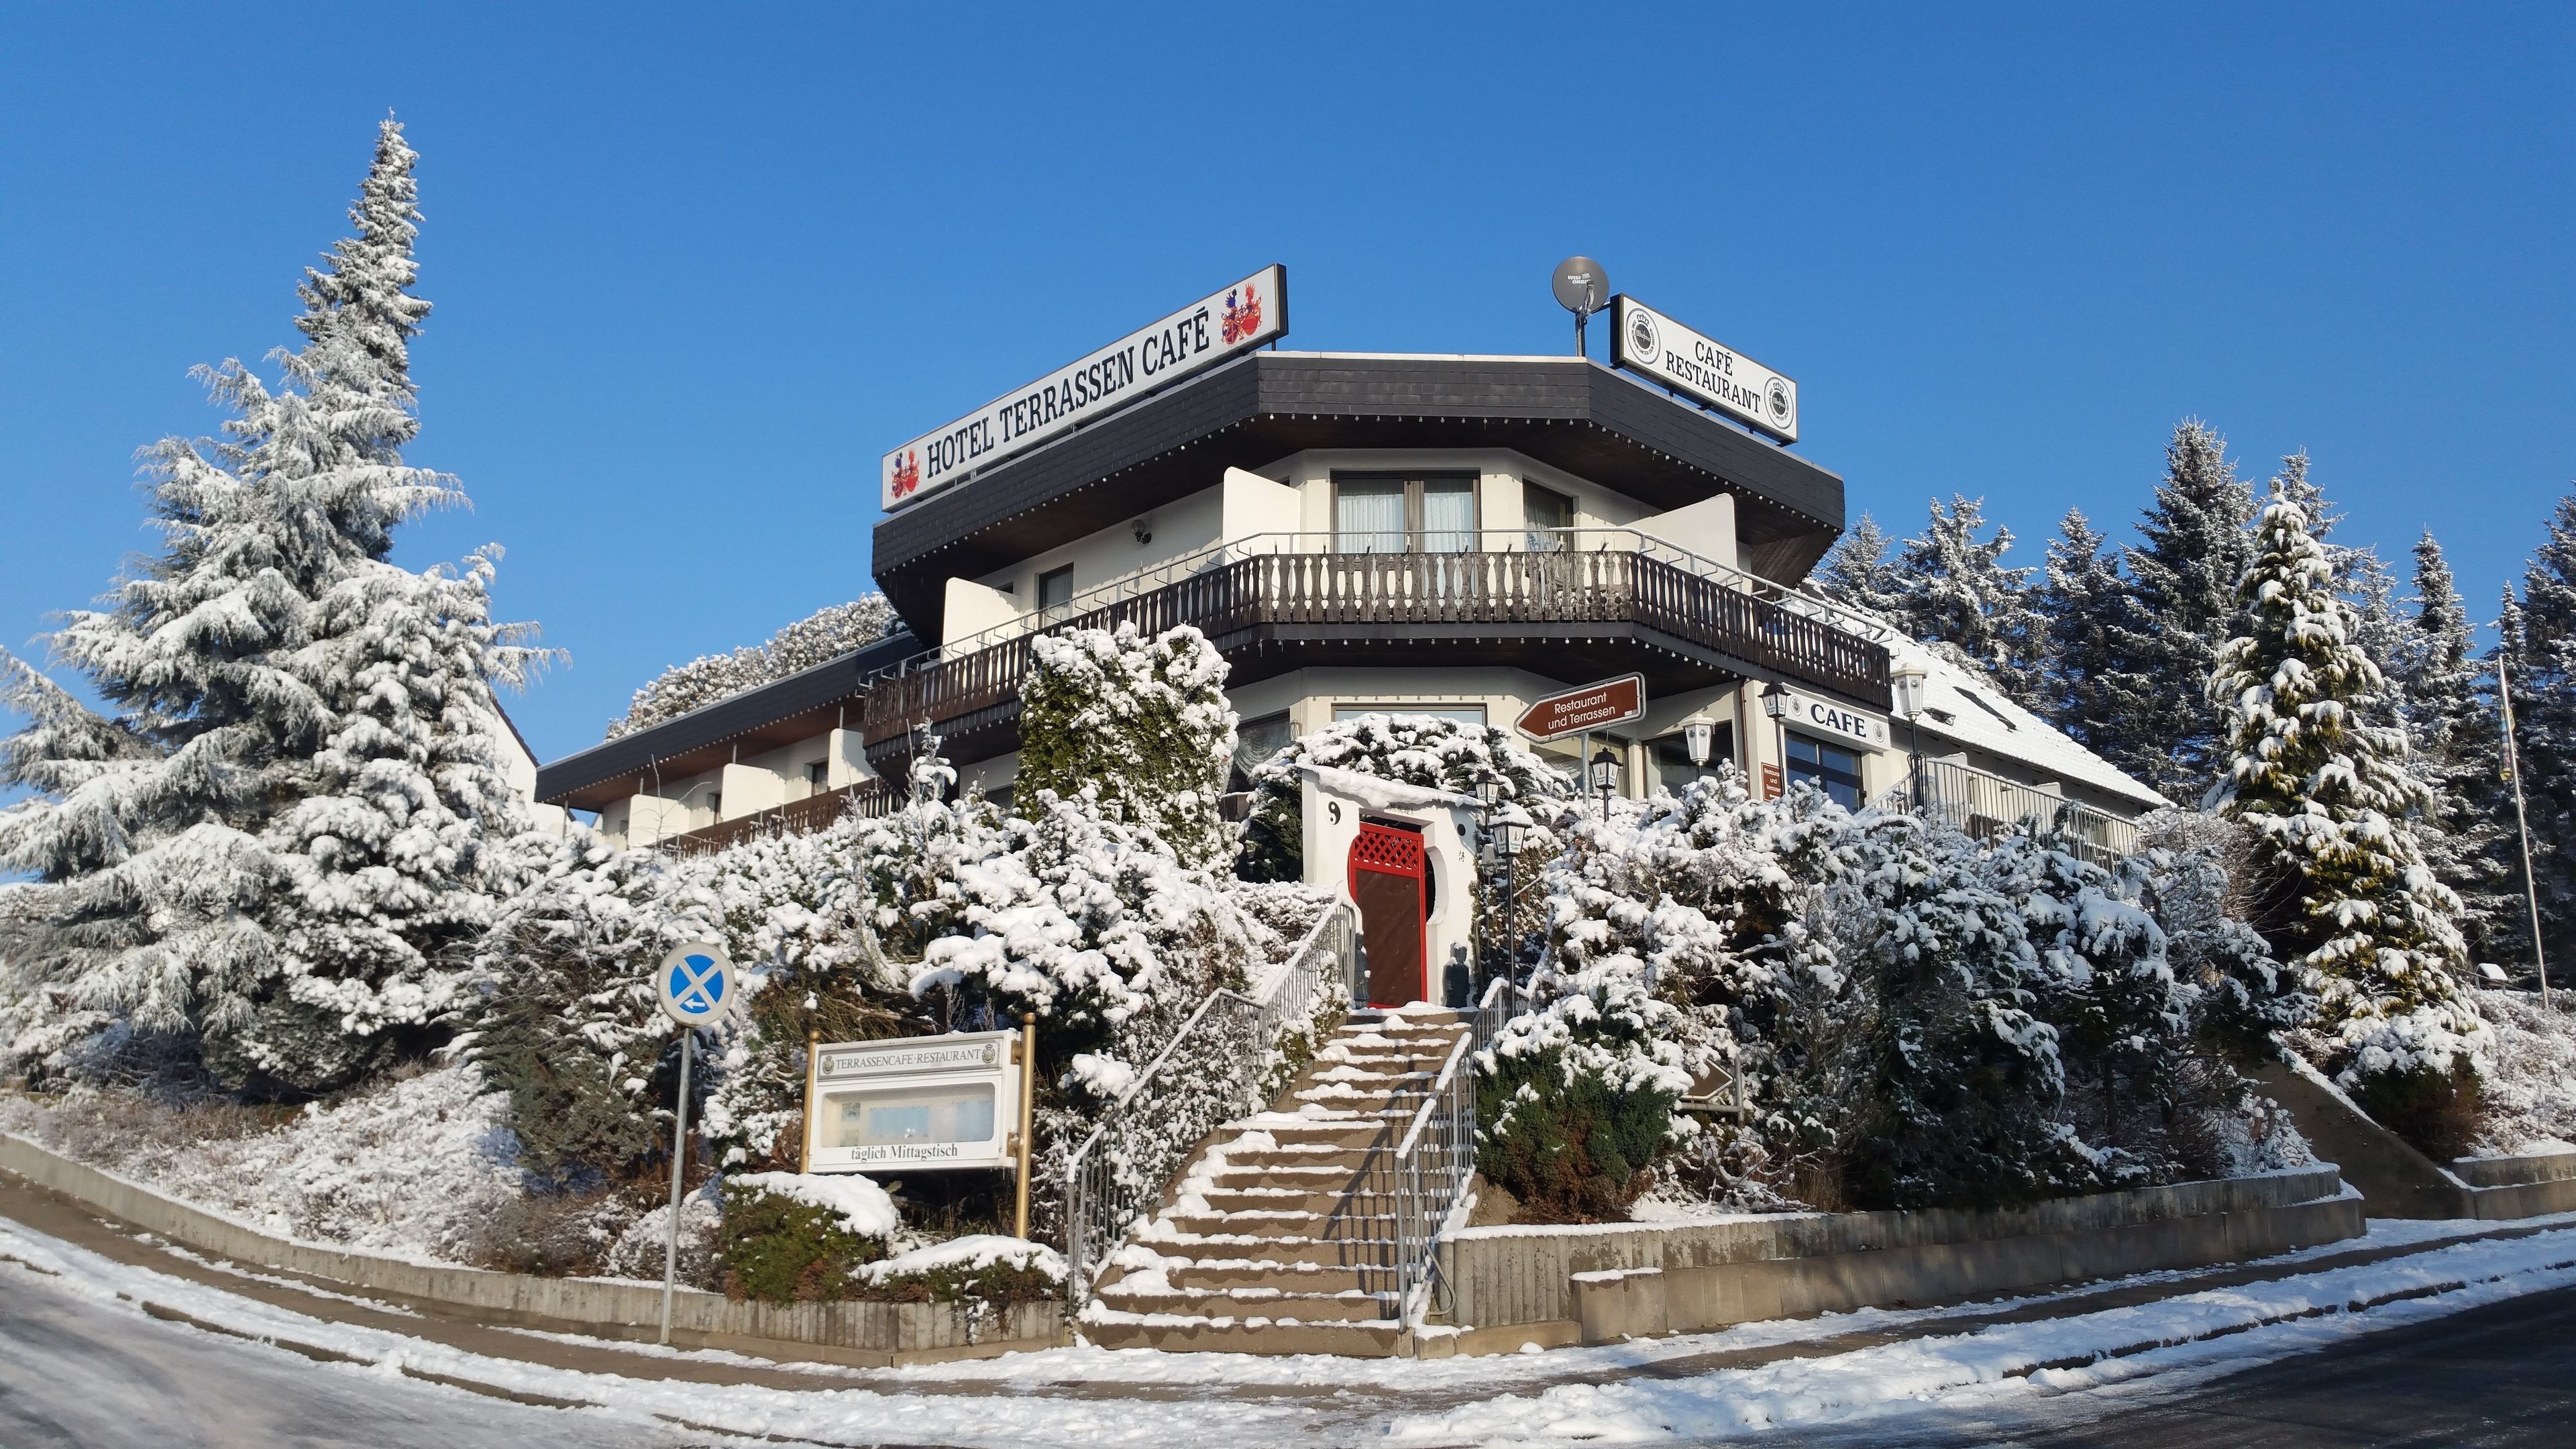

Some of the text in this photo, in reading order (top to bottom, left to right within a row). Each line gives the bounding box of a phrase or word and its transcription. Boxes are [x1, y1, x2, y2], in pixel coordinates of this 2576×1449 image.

[1695, 341, 1733, 376] CAFÉ
[927, 307, 1210, 478] HOTEL TERRASSEN CAFÉ
[1666, 350, 1761, 414] RESTAURANT
[1548, 706, 1615, 730] und Terrassen
[1554, 692, 1607, 714] Restaurant
[1810, 704, 1866, 738] CAFE
[851, 1143, 957, 1162] täglich Mittagstisch
